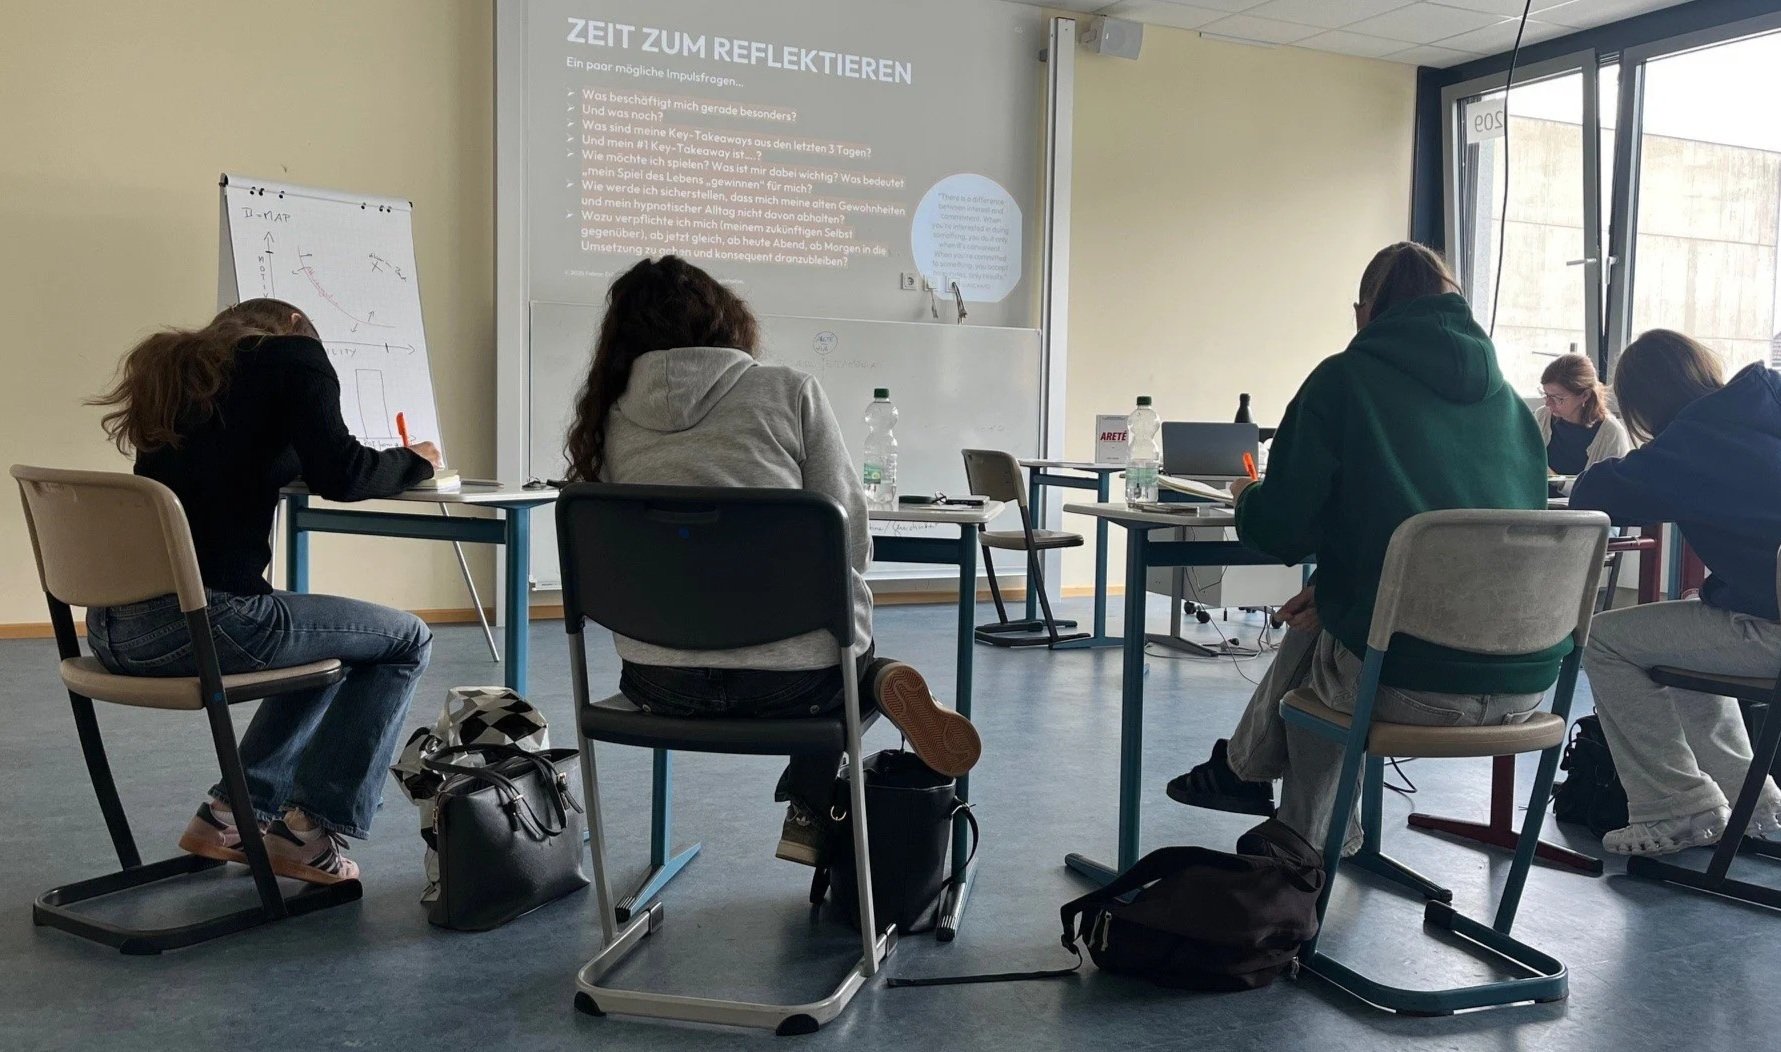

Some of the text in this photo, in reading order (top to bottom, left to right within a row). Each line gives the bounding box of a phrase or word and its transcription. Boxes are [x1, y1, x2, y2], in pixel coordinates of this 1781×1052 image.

[566, 17, 911, 84] ZEIT ZUM REFLEKTIEREN
[566, 57, 583, 68] Ein
[586, 62, 612, 72] paar
[615, 63, 664, 78] mögliche
[582, 89, 796, 120] Was beschäftigt mich gerade besonders?
[582, 104, 663, 121] Und was noch?
[582, 119, 871, 158] Was sind meine Key-Takeaways aus den letzten 3 Tagen?
[582, 134, 604, 146] Und
[607, 138, 633, 148] mein
[636, 139, 648, 150] #1
[650, 140, 730, 160] Key-Takeaway
[582, 150, 904, 187] Wie möchte ich spielen? Was ist mir dabei wichtig? Was bedeutet
[617, 168, 643, 181] Spiel
[645, 170, 664, 182] des
[666, 172, 703, 185] Lebens
[766, 180, 781, 191] für
[783, 182, 812, 193] mich?
[581, 179, 905, 215] Wie werde ich sicherstellen, dass mich meine alten Gewohnheiten
[581, 196, 844, 224] und mein hypnotischer Alltag nicht davon abhalten?
[581, 210, 852, 238] Wozu verpflichte ich mich (meinem zukünftigen Selbst
[580, 227, 886, 256] gegenüber), ab jetzt gleich, ab heute Abend, ab Morgen in die
[581, 240, 642, 256] Umsetzung
[658, 246, 692, 258] gehen
[693, 248, 712, 258] und
[714, 248, 772, 263] konsequent
[774, 252, 848, 266] dranzubleiben?
[1100, 430, 1127, 440] ARETÉ
